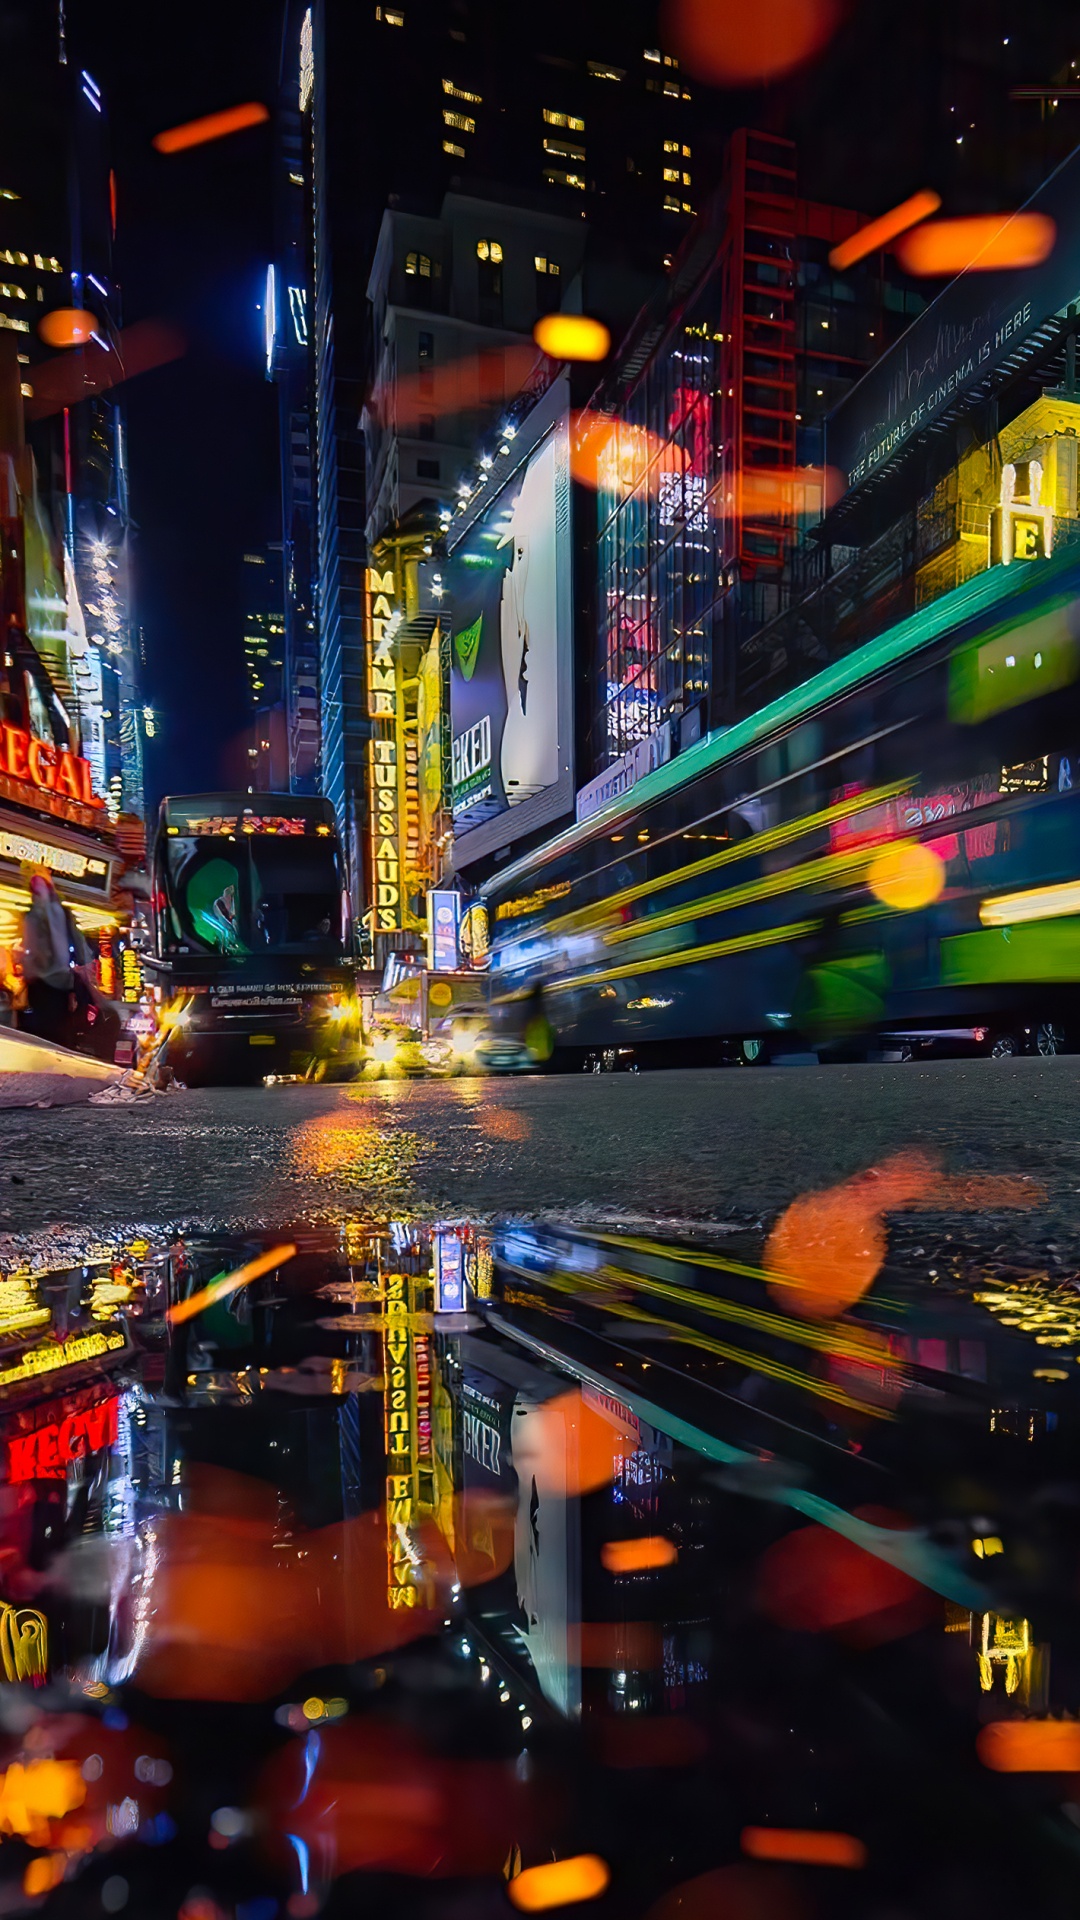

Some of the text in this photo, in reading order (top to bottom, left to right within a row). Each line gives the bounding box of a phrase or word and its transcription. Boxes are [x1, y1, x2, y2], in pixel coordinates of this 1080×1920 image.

[847, 458, 866, 487] THE
[868, 420, 907, 468] FUTURE
[910, 402, 926, 428] OF
[927, 358, 974, 411] CINEMA
[978, 341, 990, 365] IS
[995, 301, 1032, 349] HERE
[0, 721, 106, 809] EGAL
